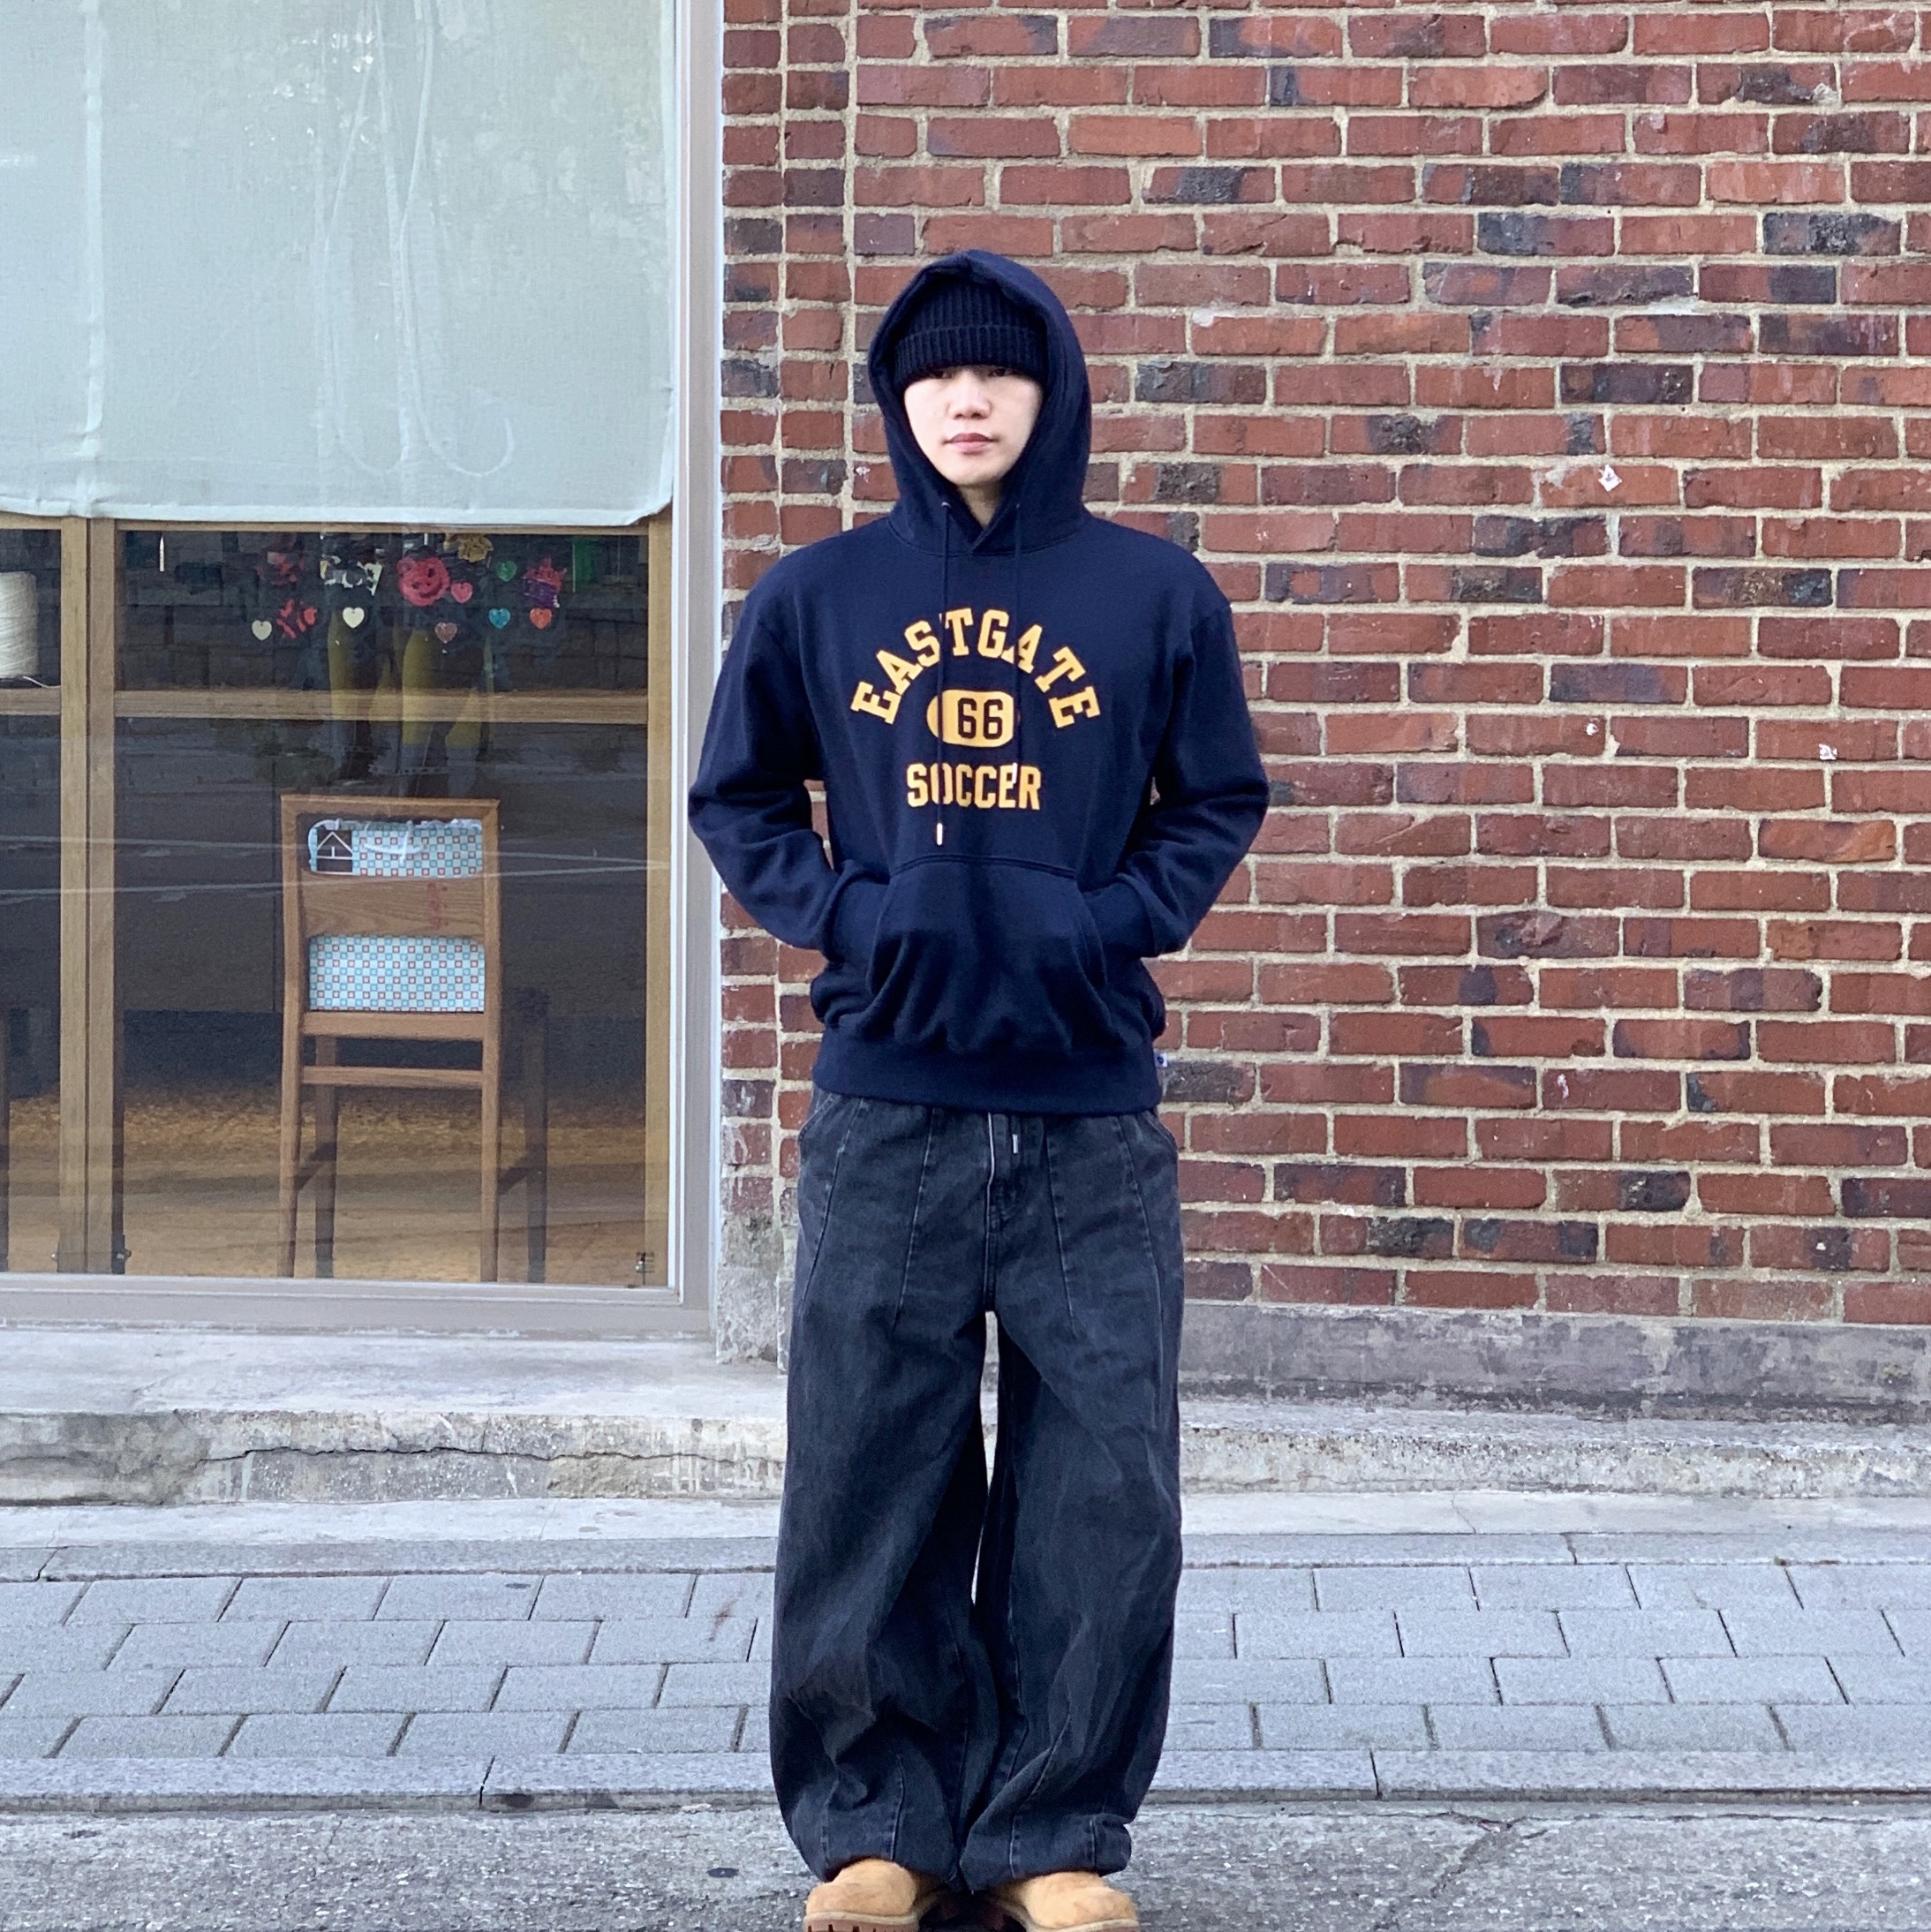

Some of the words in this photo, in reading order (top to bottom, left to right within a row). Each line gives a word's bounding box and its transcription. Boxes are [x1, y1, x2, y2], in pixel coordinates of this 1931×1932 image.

[850, 608, 1100, 728] EASTGATE
[957, 697, 1003, 740] 66
[906, 763, 1041, 810] SOCCER
